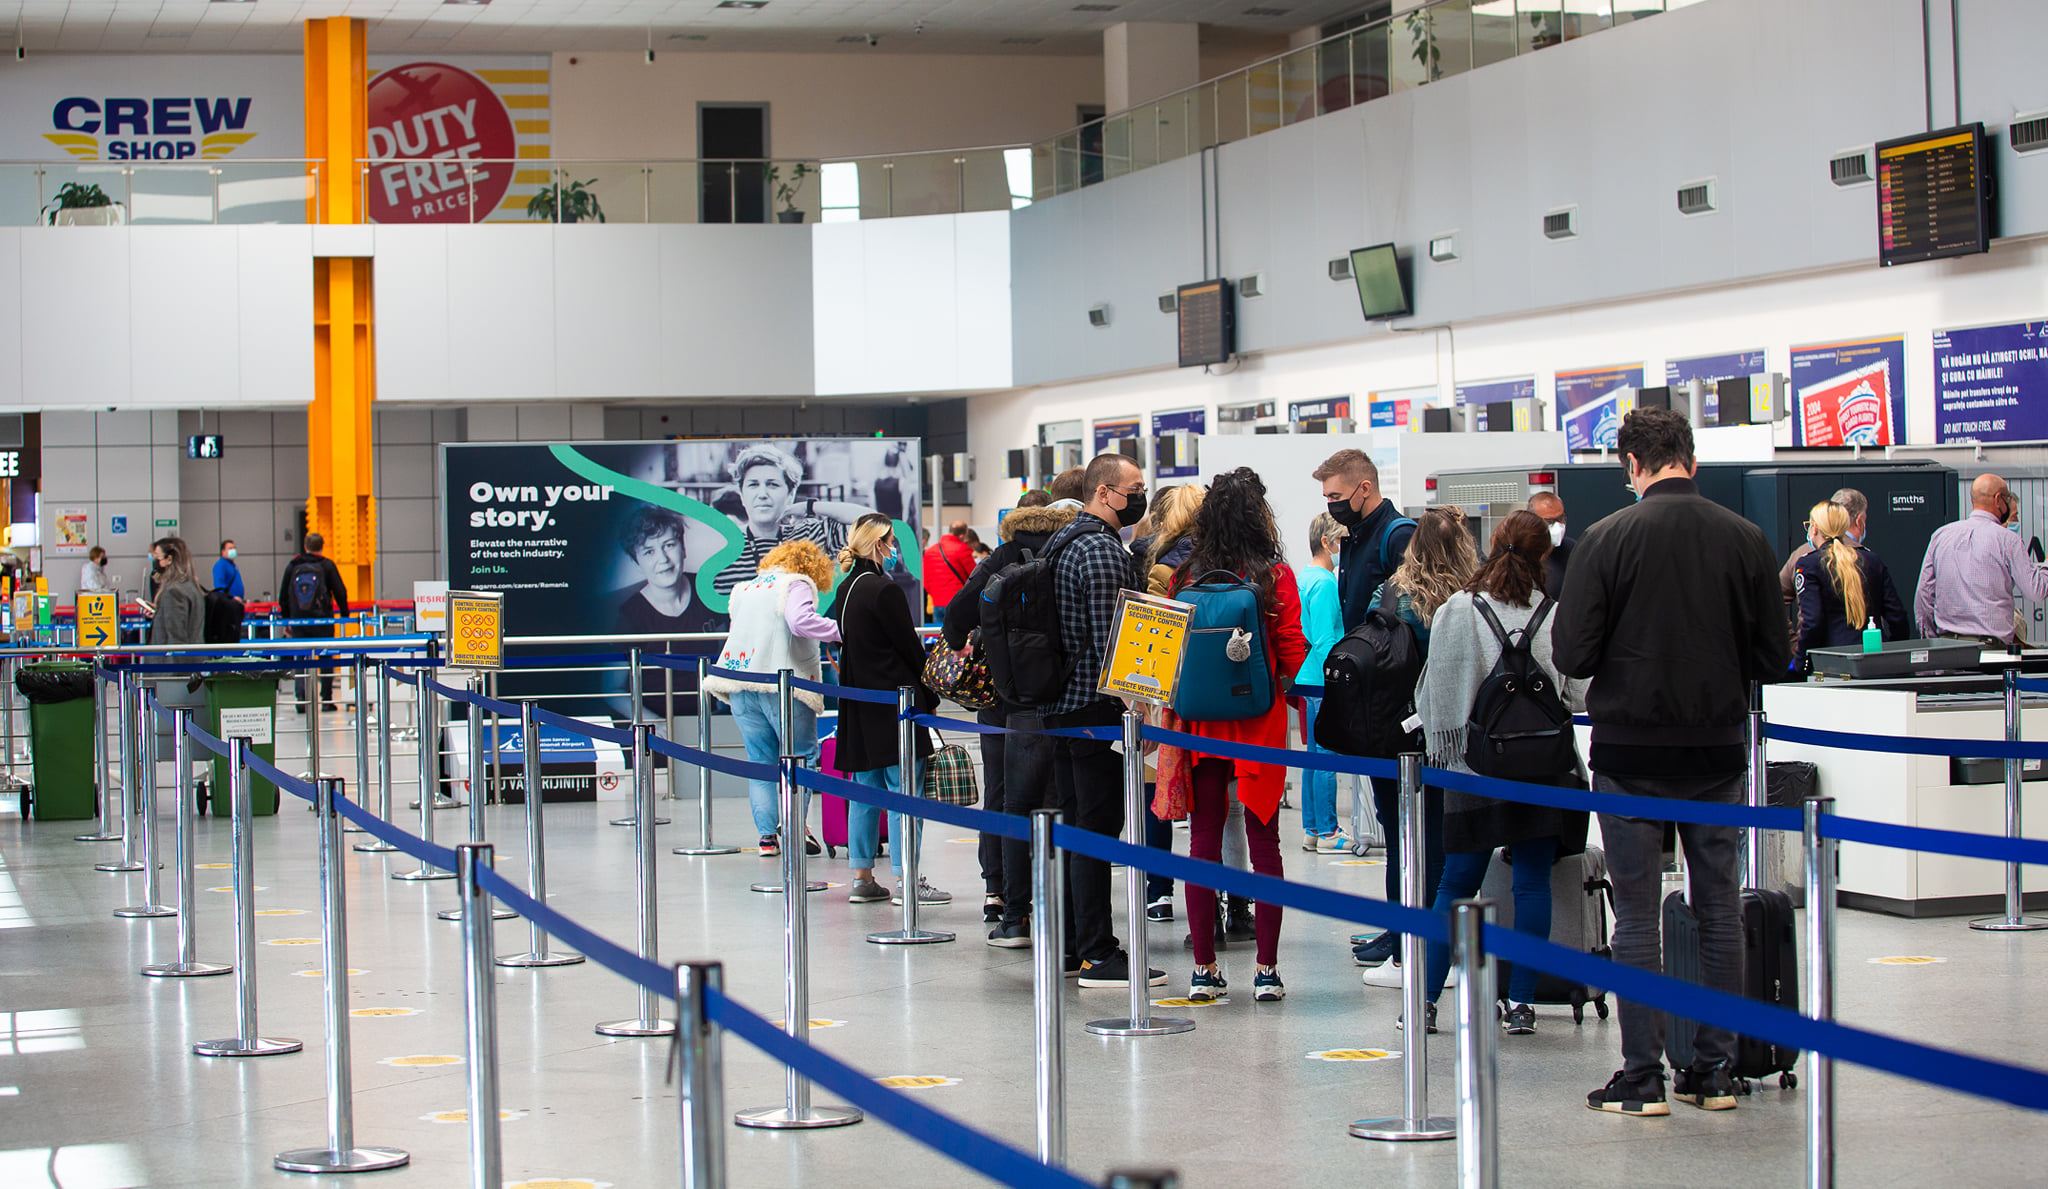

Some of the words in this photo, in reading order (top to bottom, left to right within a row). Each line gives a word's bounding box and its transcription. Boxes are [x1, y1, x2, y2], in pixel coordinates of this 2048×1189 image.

[52, 97, 252, 135] CREW
[367, 99, 476, 166] DUTY
[108, 141, 196, 160] SHOP
[380, 142, 490, 206] FREE
[2039, 346, 2048, 359] NA
[1949, 370, 1966, 383] GURA
[1966, 369, 1975, 381] CU
[1753, 383, 1770, 411] 12
[1619, 398, 1632, 423] 11
[1806, 400, 1821, 417] 2004
[1515, 407, 1528, 432] 10
[1943, 423, 1951, 434] DO
[1951, 422, 1962, 433] NOT
[1962, 421, 1978, 433] TOUCH
[1992, 419, 2006, 431] NOSE
[0, 451, 19, 477] EE
[469, 481, 538, 503] Own
[544, 485, 614, 507] your
[1892, 495, 1925, 504] smiths
[470, 507, 556, 532] story.
[470, 539, 505, 548] Elevate
[506, 538, 523, 547] the
[524, 538, 568, 547] narrative
[470, 549, 481, 558] of
[482, 549, 499, 558] the
[500, 549, 521, 558] tech
[522, 549, 565, 559] industry.
[470, 565, 491, 574] Join
[492, 565, 509, 574] Us.
[470, 581, 569, 591] nagarro.com/careers/Romania
[1127, 603, 1154, 615] CONTROL
[1128, 611, 1156, 622] SECURITY
[1157, 617, 1183, 628] CONTROL
[1112, 679, 1136, 690] OBIECTE
